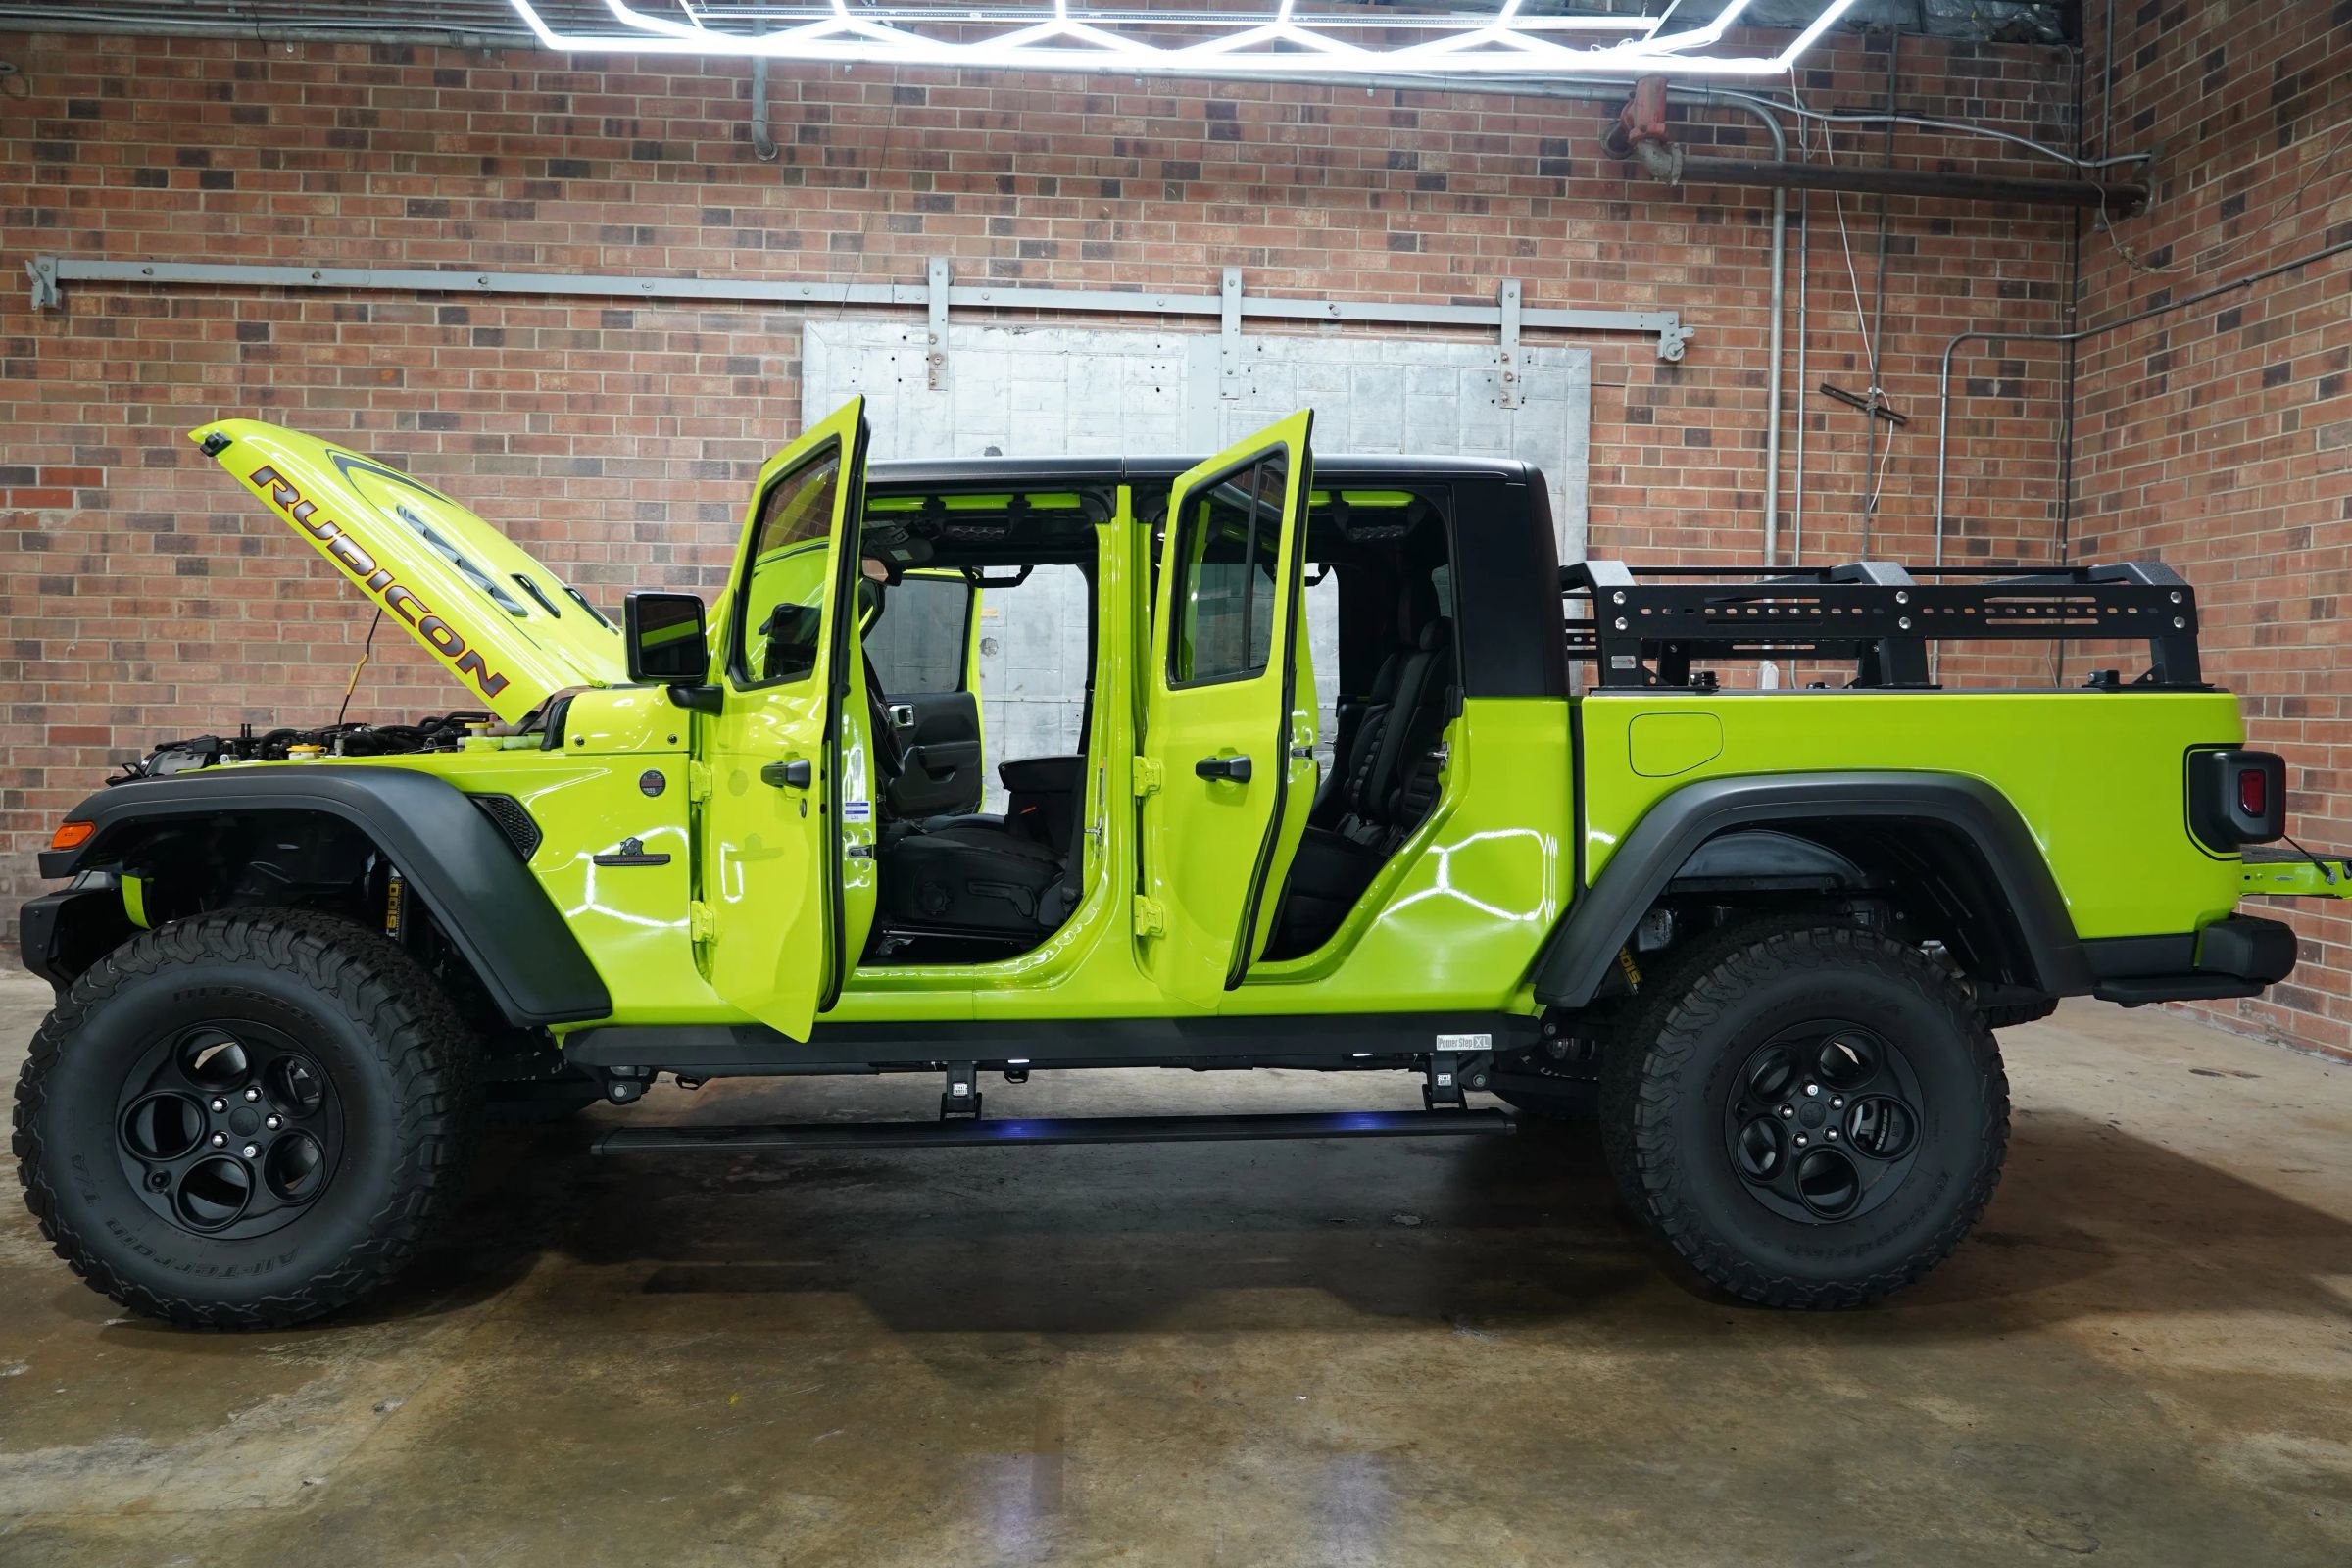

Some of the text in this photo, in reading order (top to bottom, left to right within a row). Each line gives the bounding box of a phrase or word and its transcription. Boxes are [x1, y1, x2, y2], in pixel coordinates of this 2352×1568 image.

[249, 465, 511, 699] RUBICON
[386, 883, 400, 929] 5100
[1458, 1036, 1473, 1050] Step
[1474, 1036, 1490, 1048] XL
